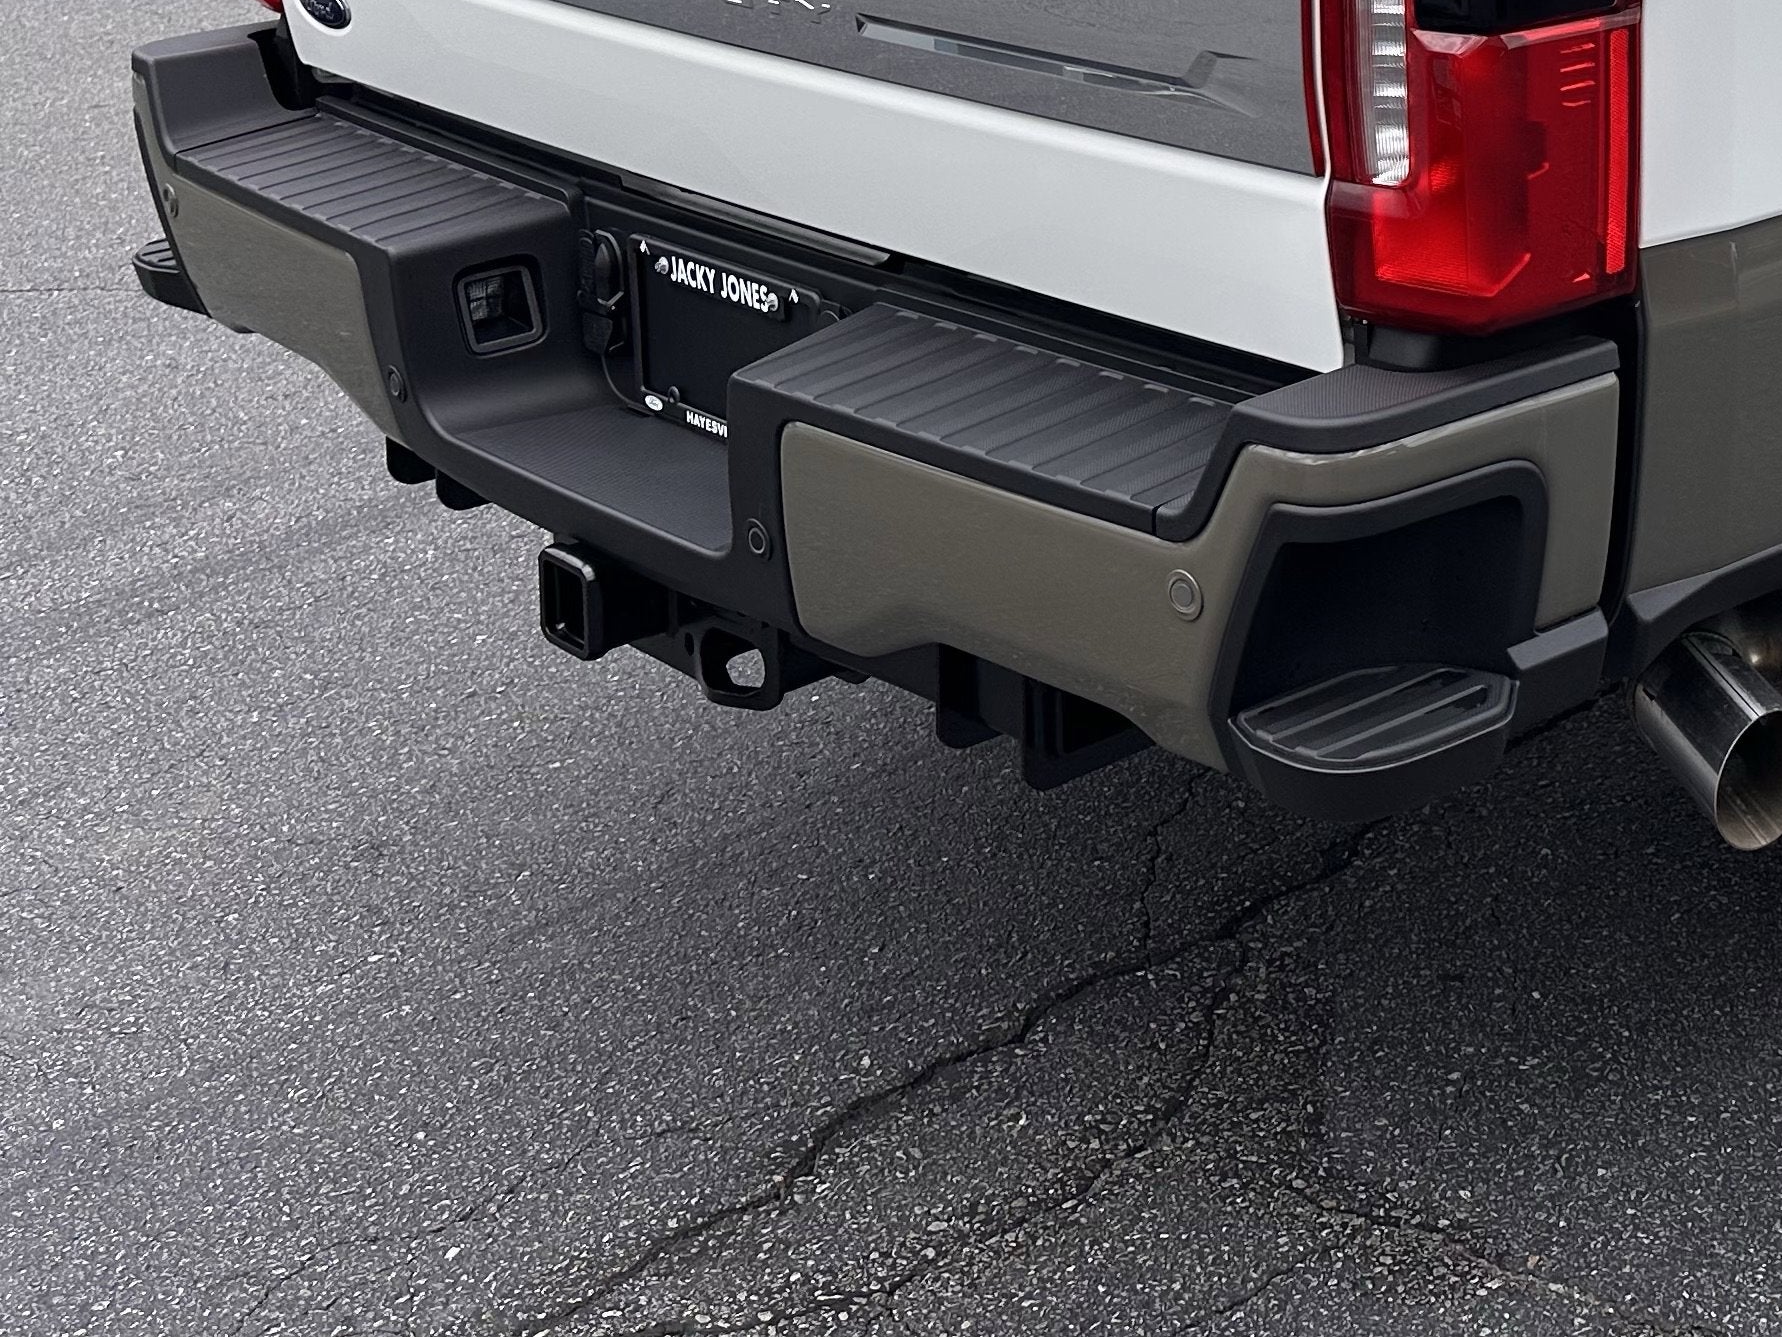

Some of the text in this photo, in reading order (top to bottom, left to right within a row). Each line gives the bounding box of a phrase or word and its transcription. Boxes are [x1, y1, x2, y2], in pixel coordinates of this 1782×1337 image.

[670, 256, 769, 313] JACKY JONES
[686, 410, 728, 438] HAYESVI
